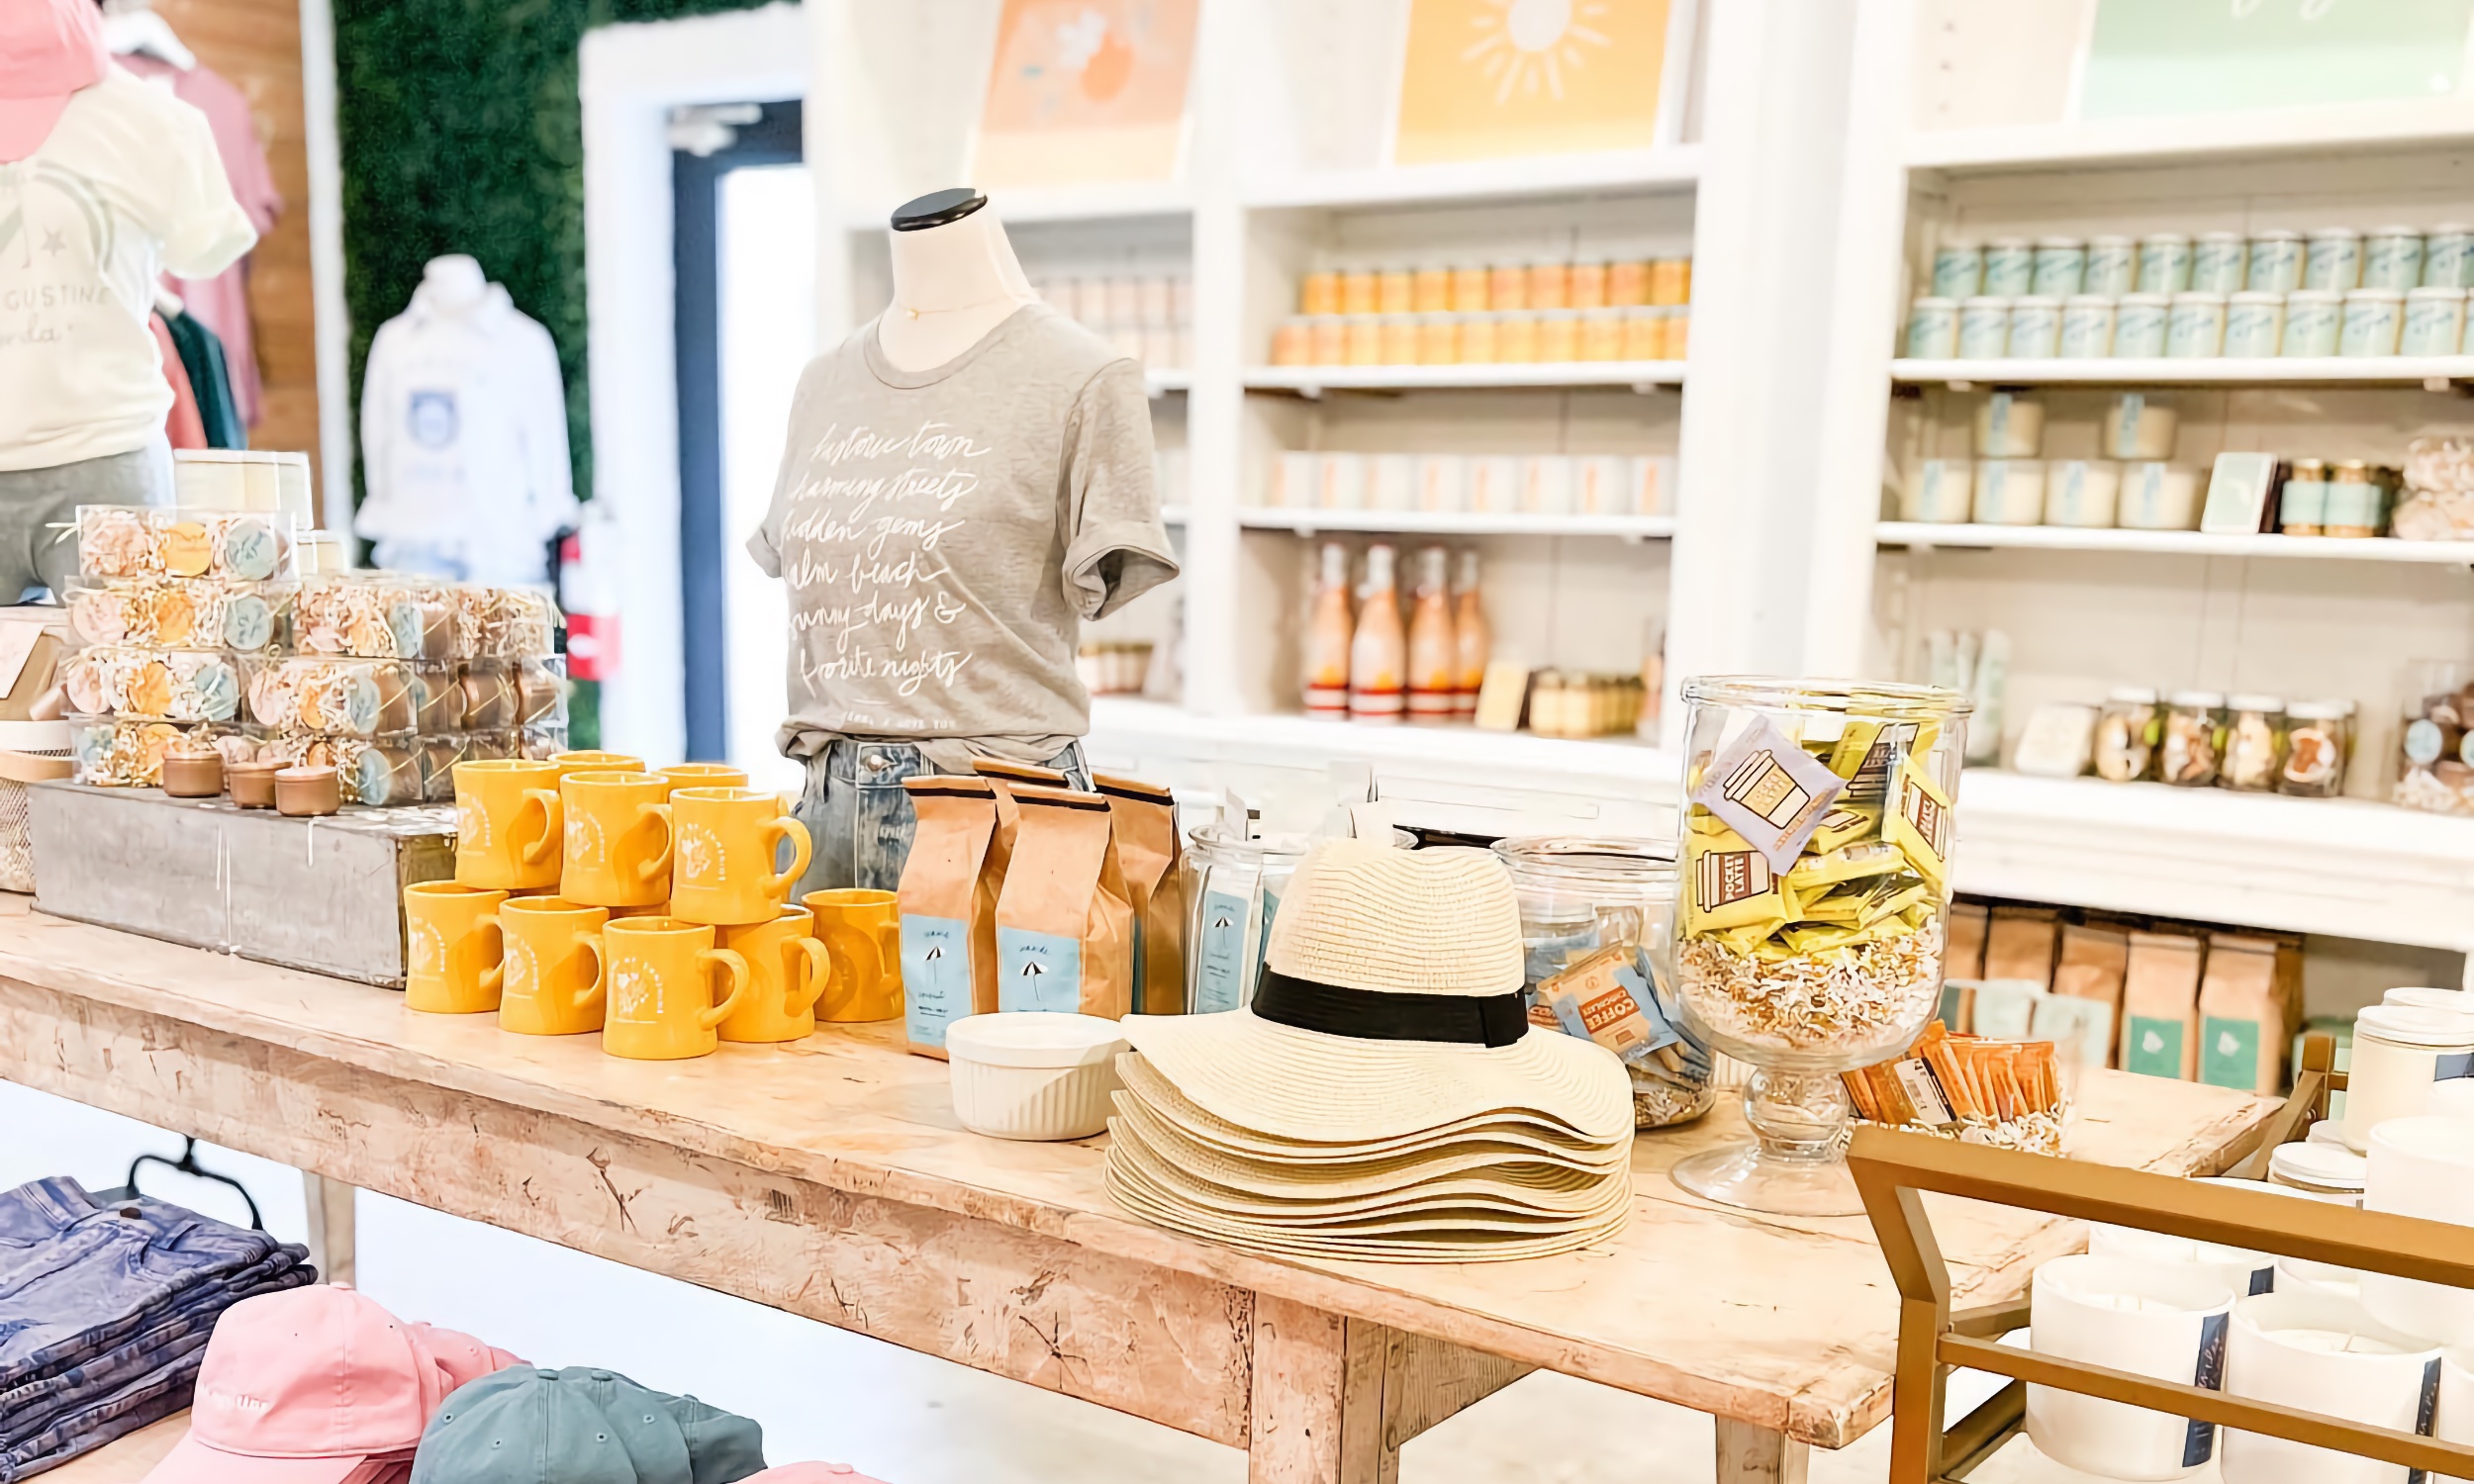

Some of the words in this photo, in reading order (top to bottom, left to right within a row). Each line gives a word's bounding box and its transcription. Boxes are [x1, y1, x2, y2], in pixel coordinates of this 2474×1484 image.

[809, 423, 910, 466] historic
[906, 419, 992, 459] town
[789, 471, 886, 523] harming
[884, 468, 979, 511] streets
[868, 515, 966, 560] gems
[845, 551, 950, 594] beach
[853, 590, 930, 652] days
[934, 591, 967, 624] &
[881, 650, 974, 696] nights
[1724, 854, 1735, 901] POCKET
[1735, 857, 1745, 893] LATTE
[1585, 998, 1636, 1030] COFFEE
